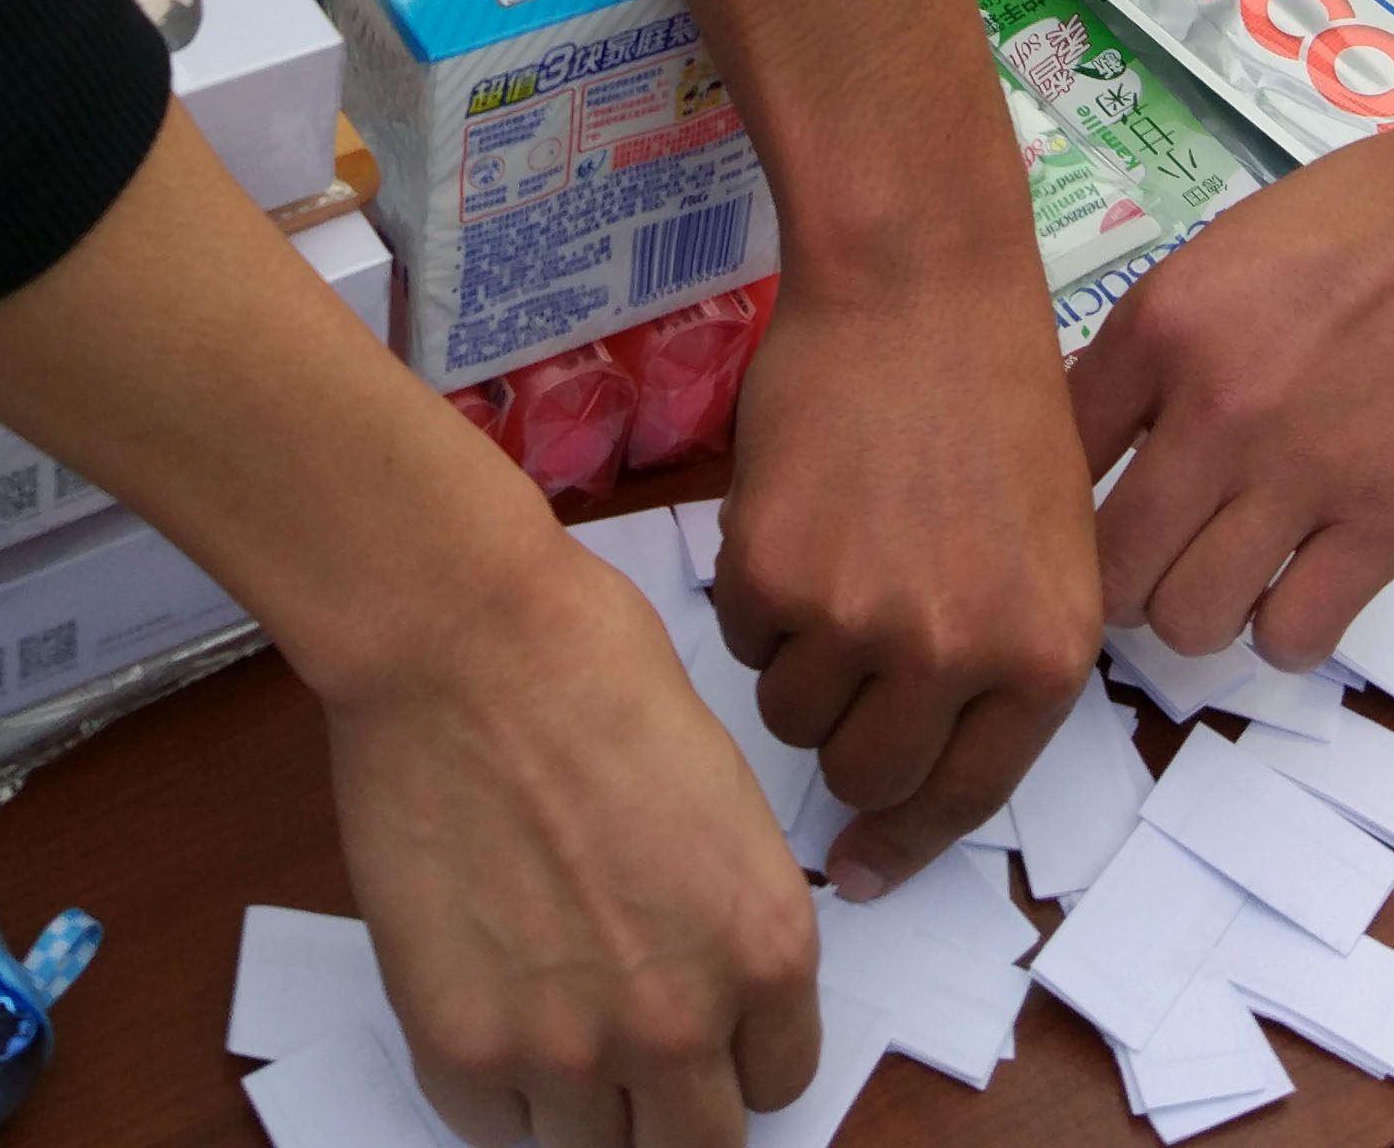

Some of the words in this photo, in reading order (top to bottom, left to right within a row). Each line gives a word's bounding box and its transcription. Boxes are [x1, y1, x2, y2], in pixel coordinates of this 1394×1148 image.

[1092, 50, 1125, 78] 新
[1076, 105, 1143, 171] kamille
[1095, 83, 1198, 182] 小甘菊
[1058, 165, 1094, 189] Hand
[1182, 173, 1229, 207] 德国
